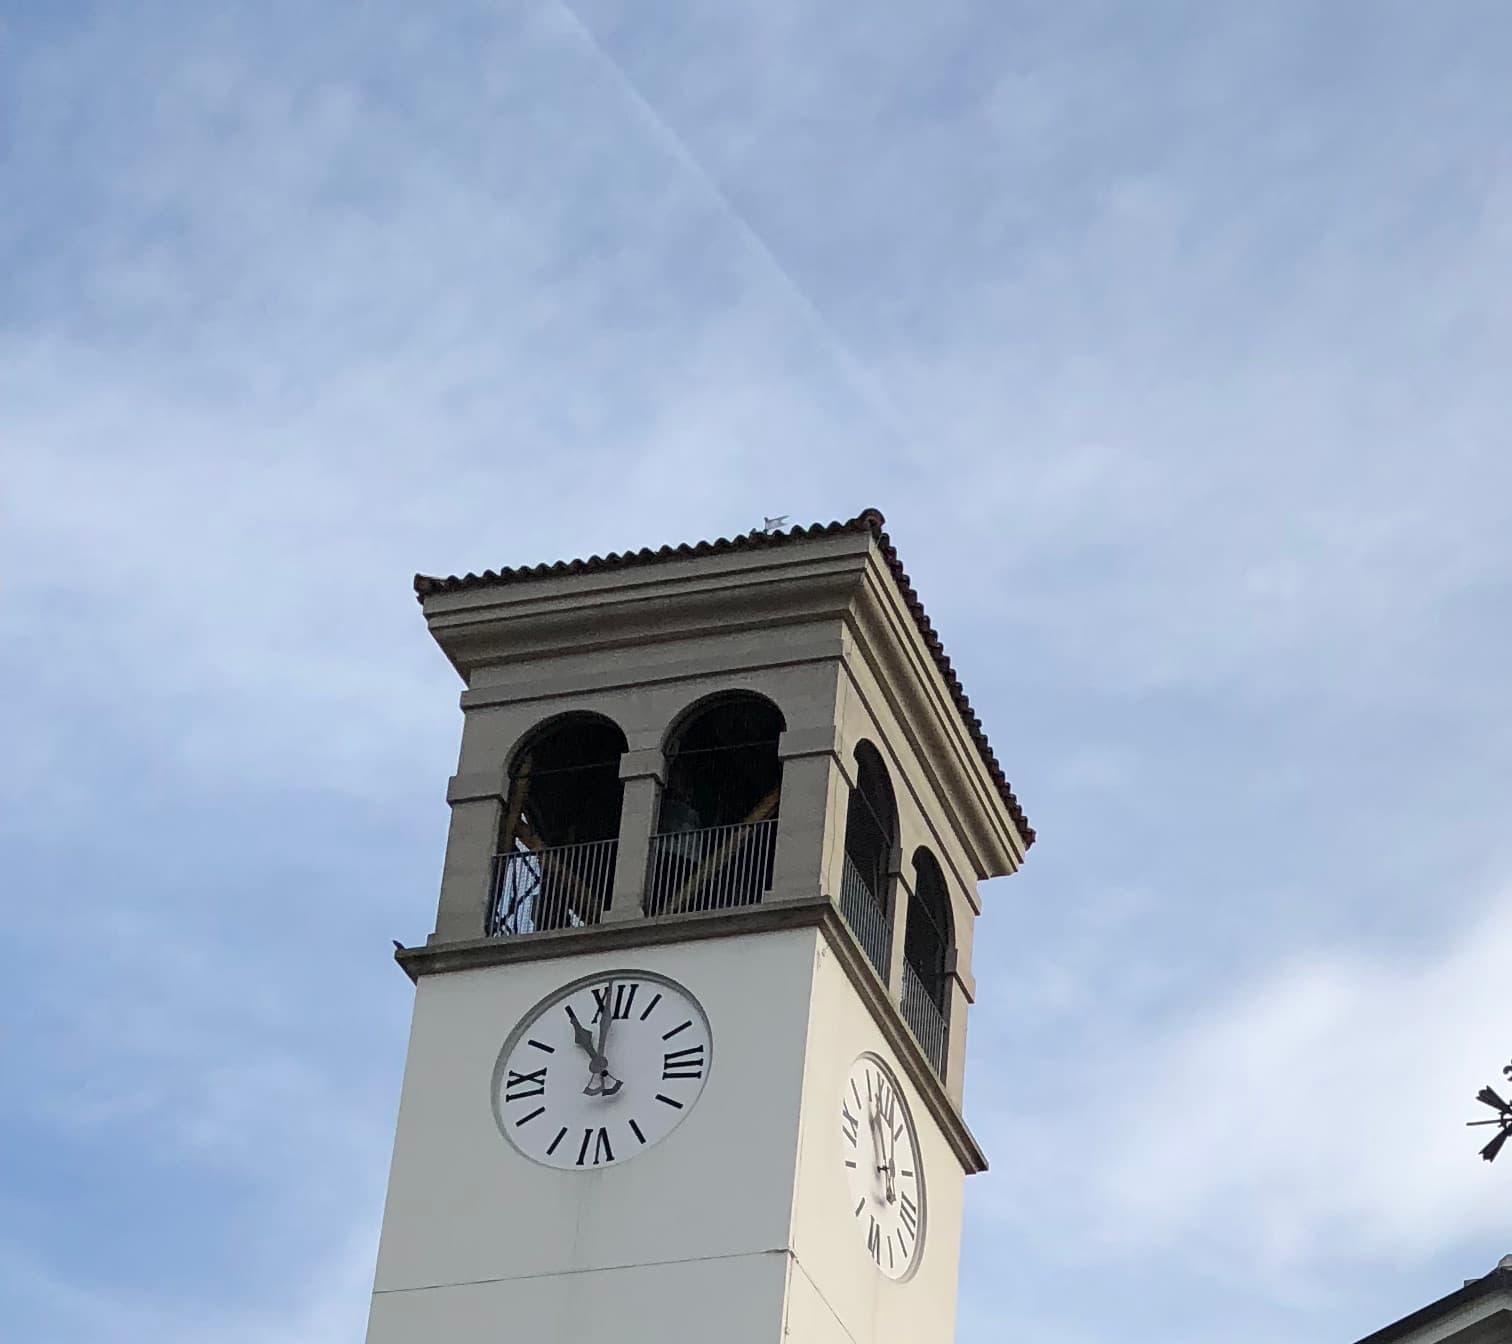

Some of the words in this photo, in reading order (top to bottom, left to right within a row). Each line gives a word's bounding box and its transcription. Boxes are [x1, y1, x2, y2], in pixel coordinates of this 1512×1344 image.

[591, 983, 639, 1024] XII
[662, 1044, 704, 1080] III
[506, 1066, 548, 1102] IX
[576, 1127, 614, 1165] VI
